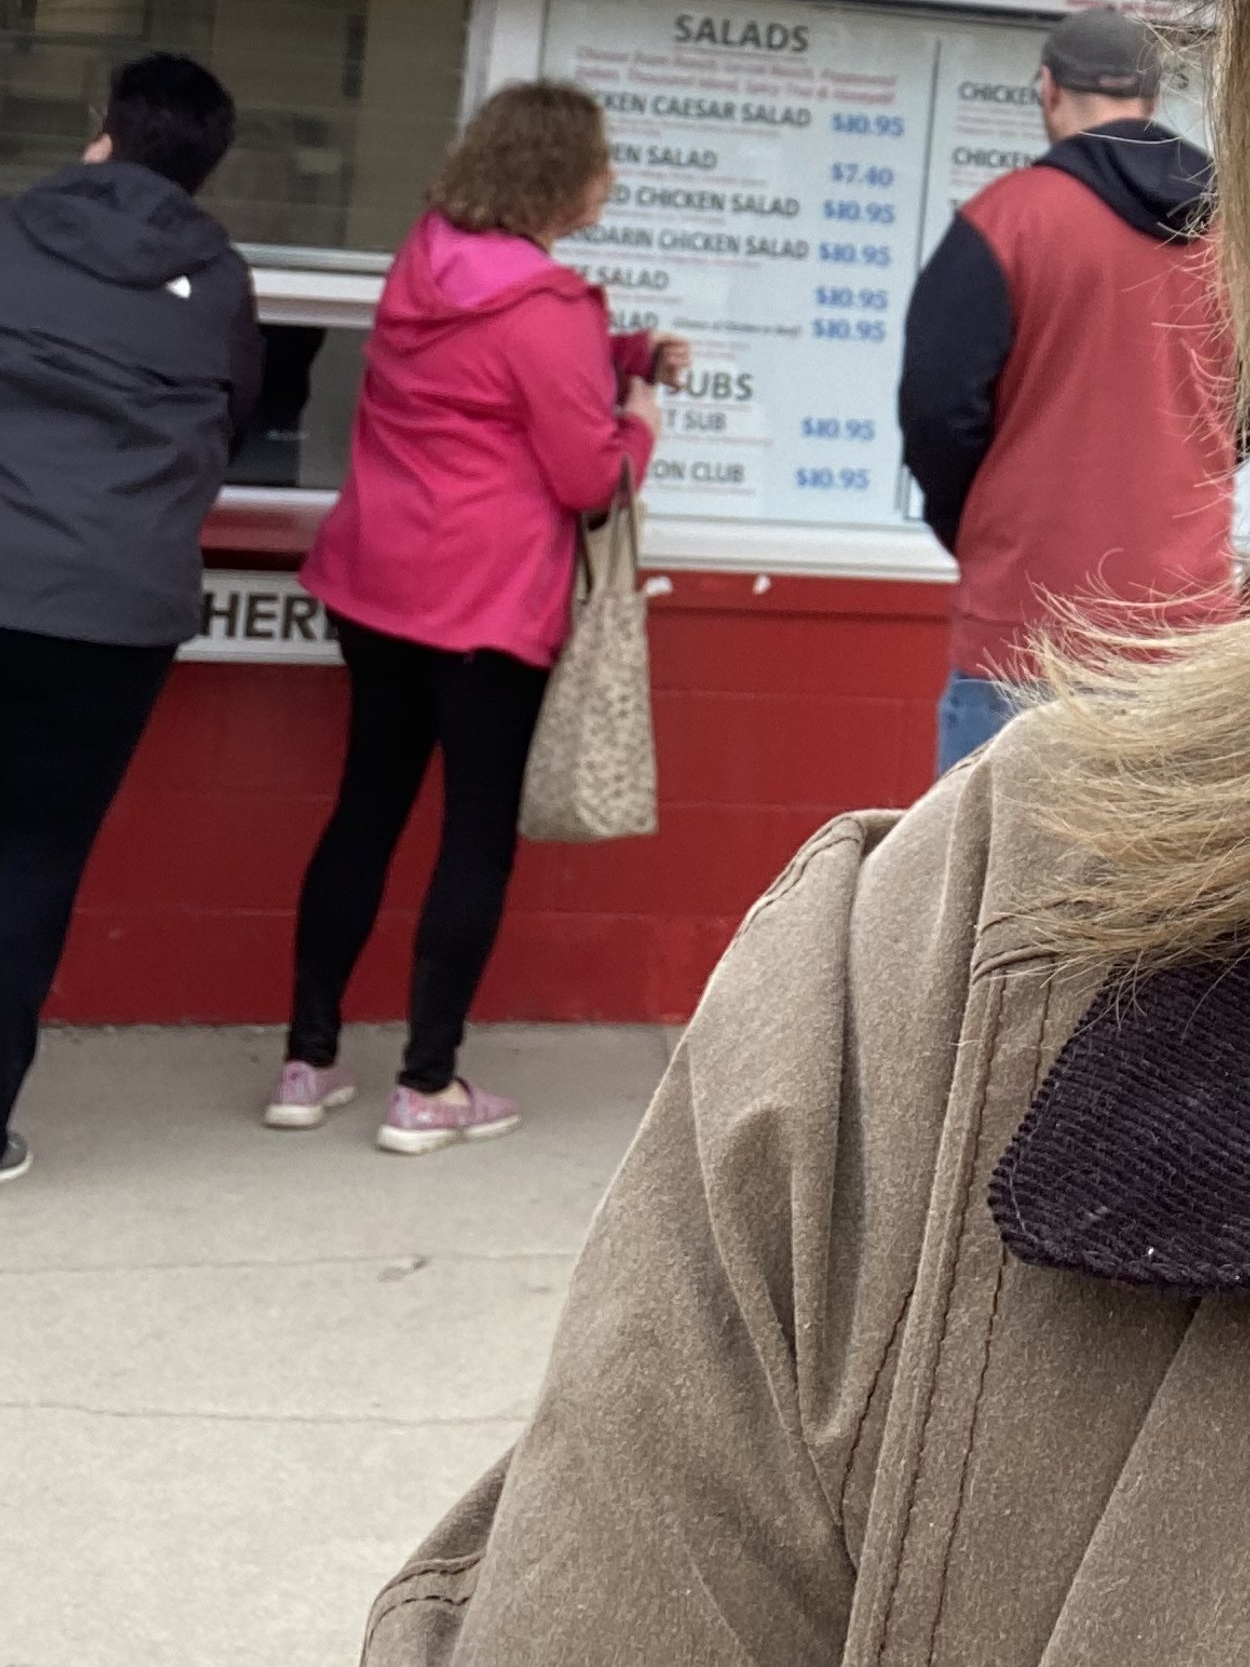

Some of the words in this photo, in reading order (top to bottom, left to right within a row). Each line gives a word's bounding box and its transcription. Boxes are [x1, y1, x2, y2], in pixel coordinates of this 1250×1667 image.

[672, 13, 810, 53] SALADS
[652, 95, 736, 122] CAESAR
[741, 101, 812, 128] SALAD
[646, 145, 718, 170] SALAD
[636, 185, 725, 213] CHICKEN
[731, 192, 801, 218] SALAD
[658, 227, 740, 255] CHICKEN
[745, 234, 811, 260] SALAD
[597, 266, 670, 291] SALAD
[684, 410, 728, 433] SUB
[690, 461, 746, 485] CLUB
